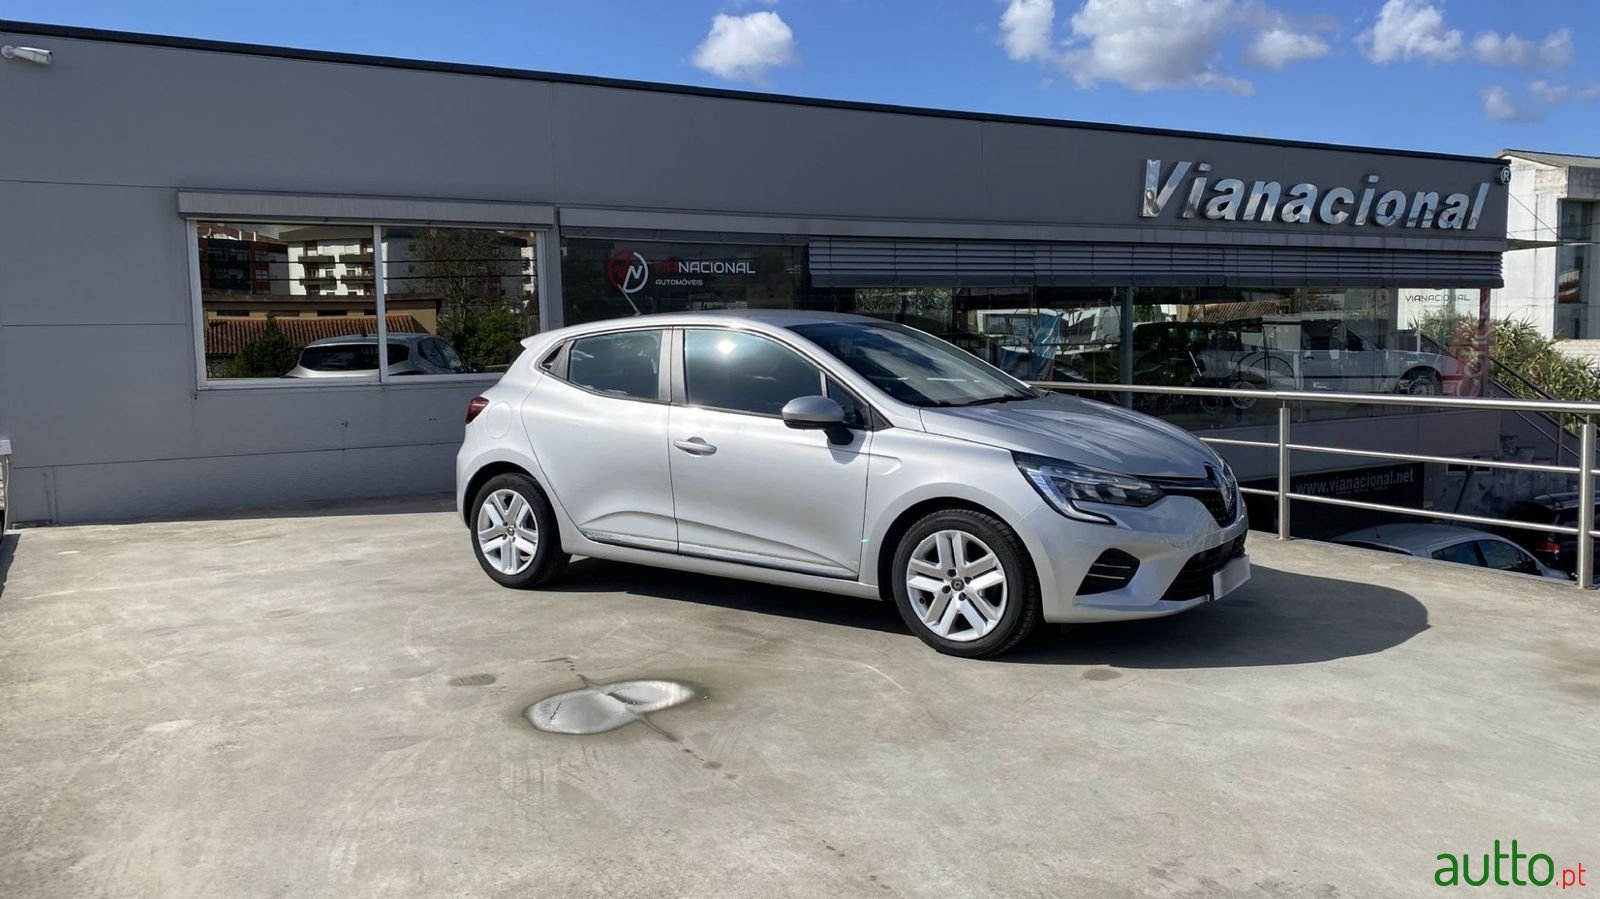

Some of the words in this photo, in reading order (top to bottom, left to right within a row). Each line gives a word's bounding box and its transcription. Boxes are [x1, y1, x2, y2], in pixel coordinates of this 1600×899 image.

[1140, 158, 1490, 231] Vianacional
[653, 259, 756, 274] NACIONAL
[1405, 294, 1471, 302] VIANACOAL
[1296, 467, 1415, 495] www.vianacional.net
